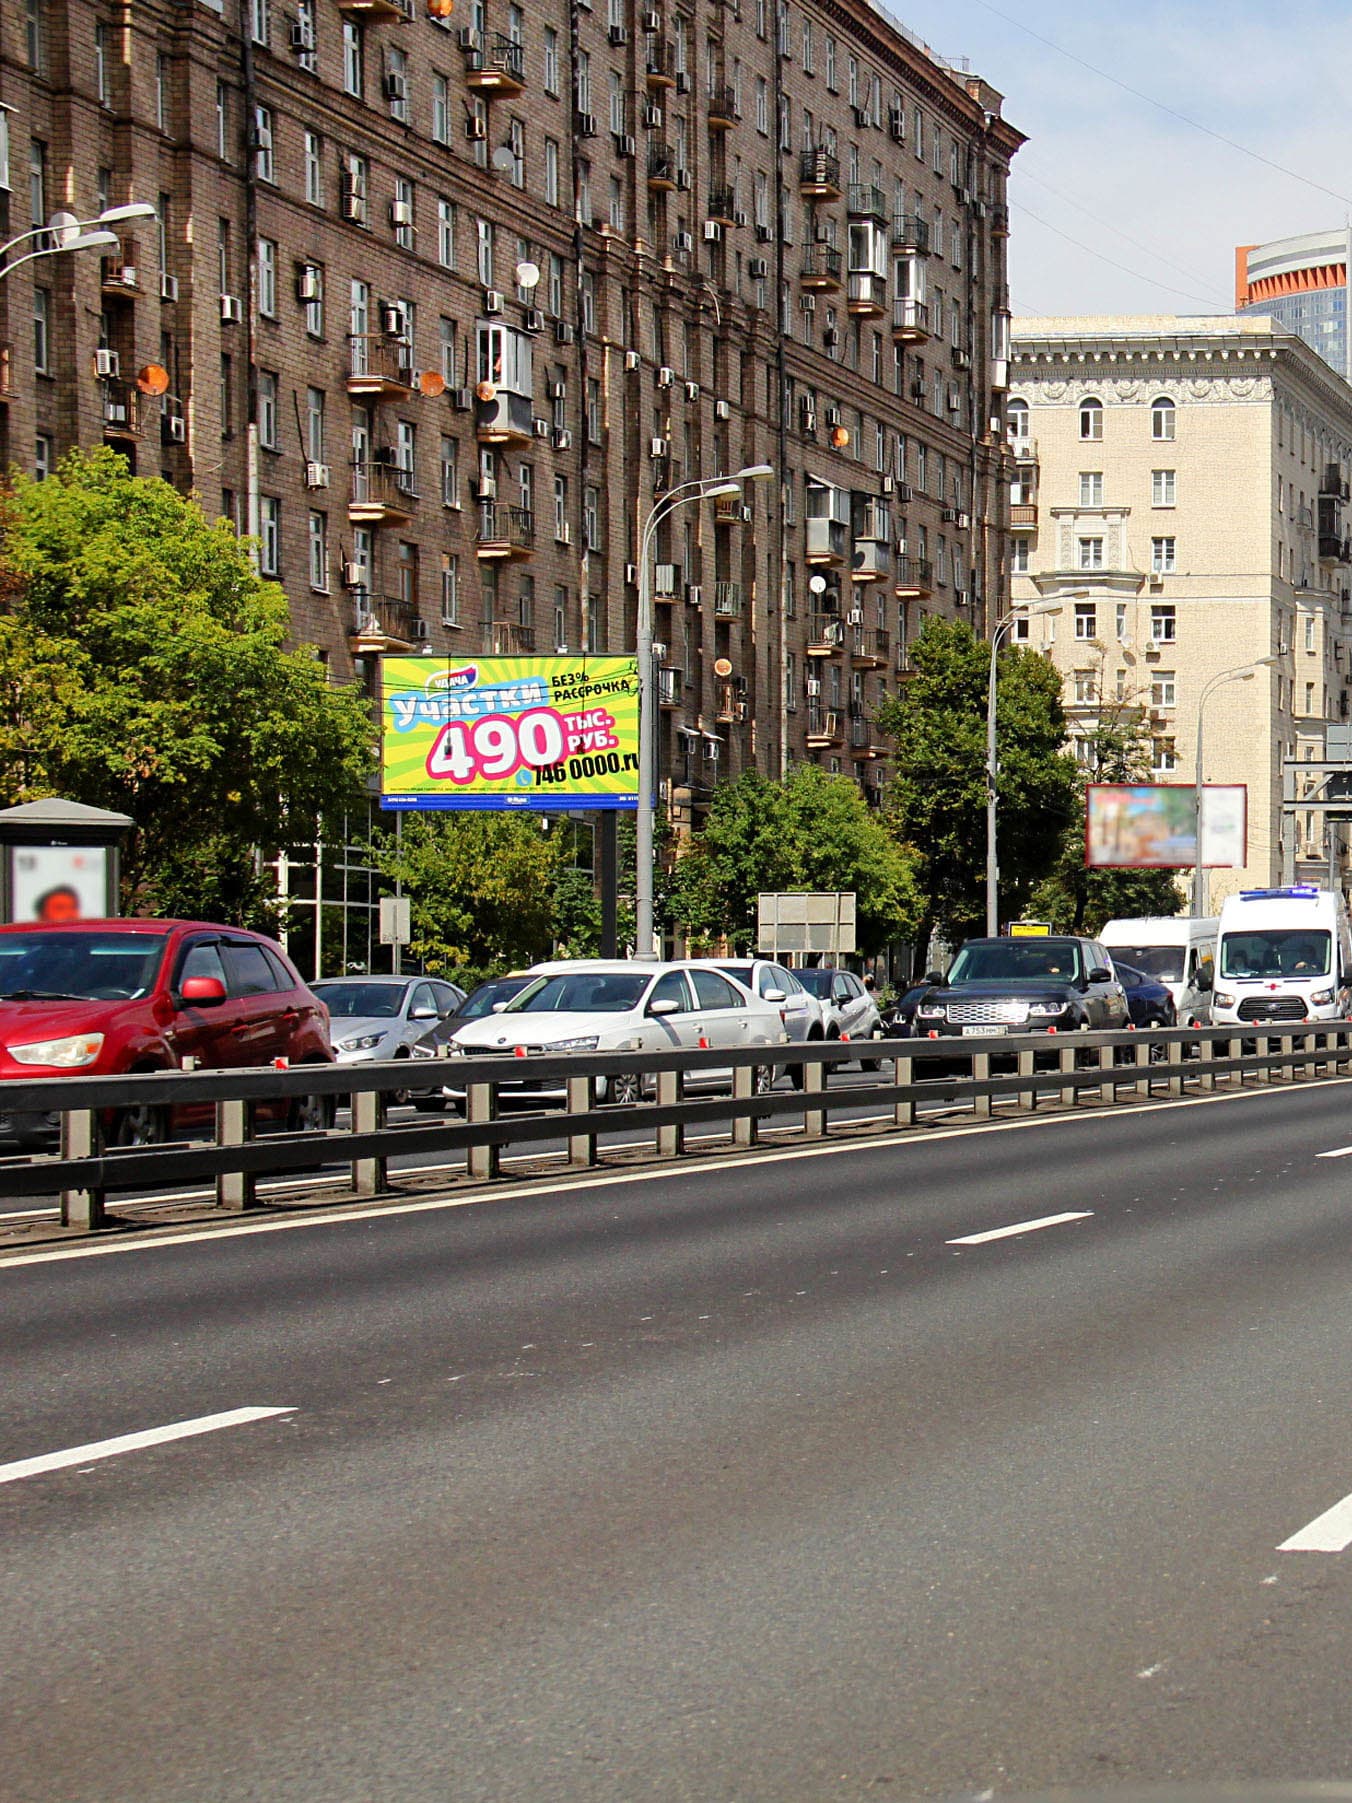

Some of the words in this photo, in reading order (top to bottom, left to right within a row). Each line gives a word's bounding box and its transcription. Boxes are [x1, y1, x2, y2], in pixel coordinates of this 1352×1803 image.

[554, 679, 631, 702] РАССРОЧКА
[564, 710, 612, 732] ТЫС.
[430, 712, 563, 780] 490
[567, 730, 615, 752] РУБ.
[532, 761, 567, 786] 746
